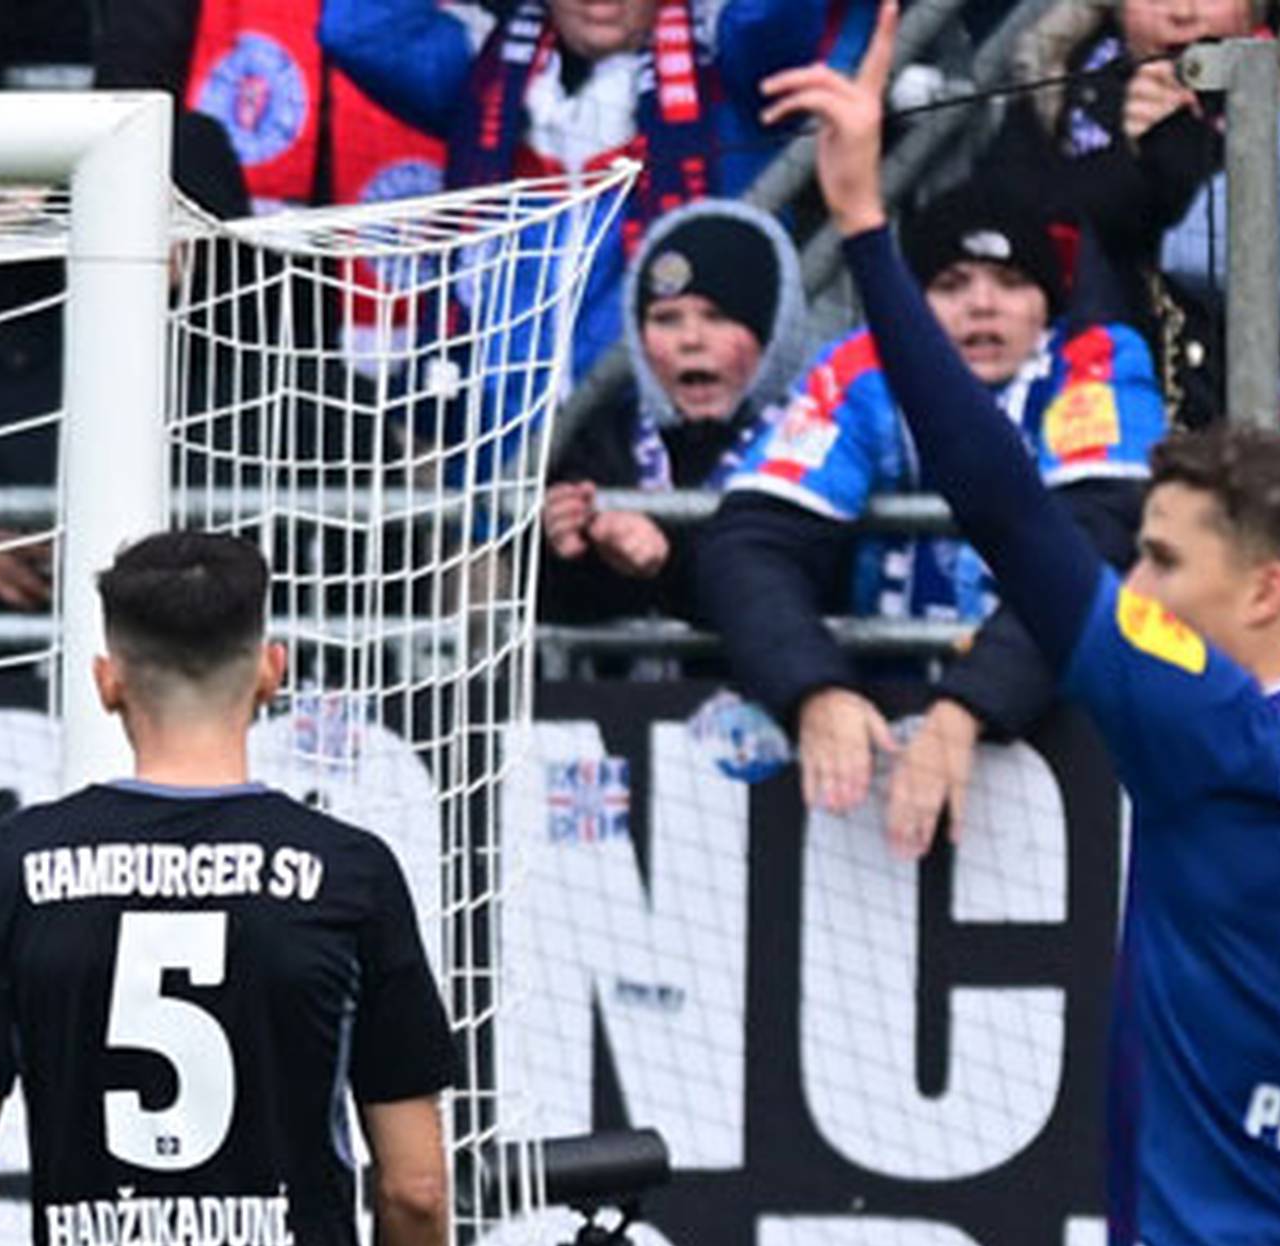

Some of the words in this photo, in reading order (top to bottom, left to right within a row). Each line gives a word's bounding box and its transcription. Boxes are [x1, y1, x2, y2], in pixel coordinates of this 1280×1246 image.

[23, 843, 264, 904] HAMBURGER
[268, 846, 323, 902] SV
[103, 910, 236, 1171] 5
